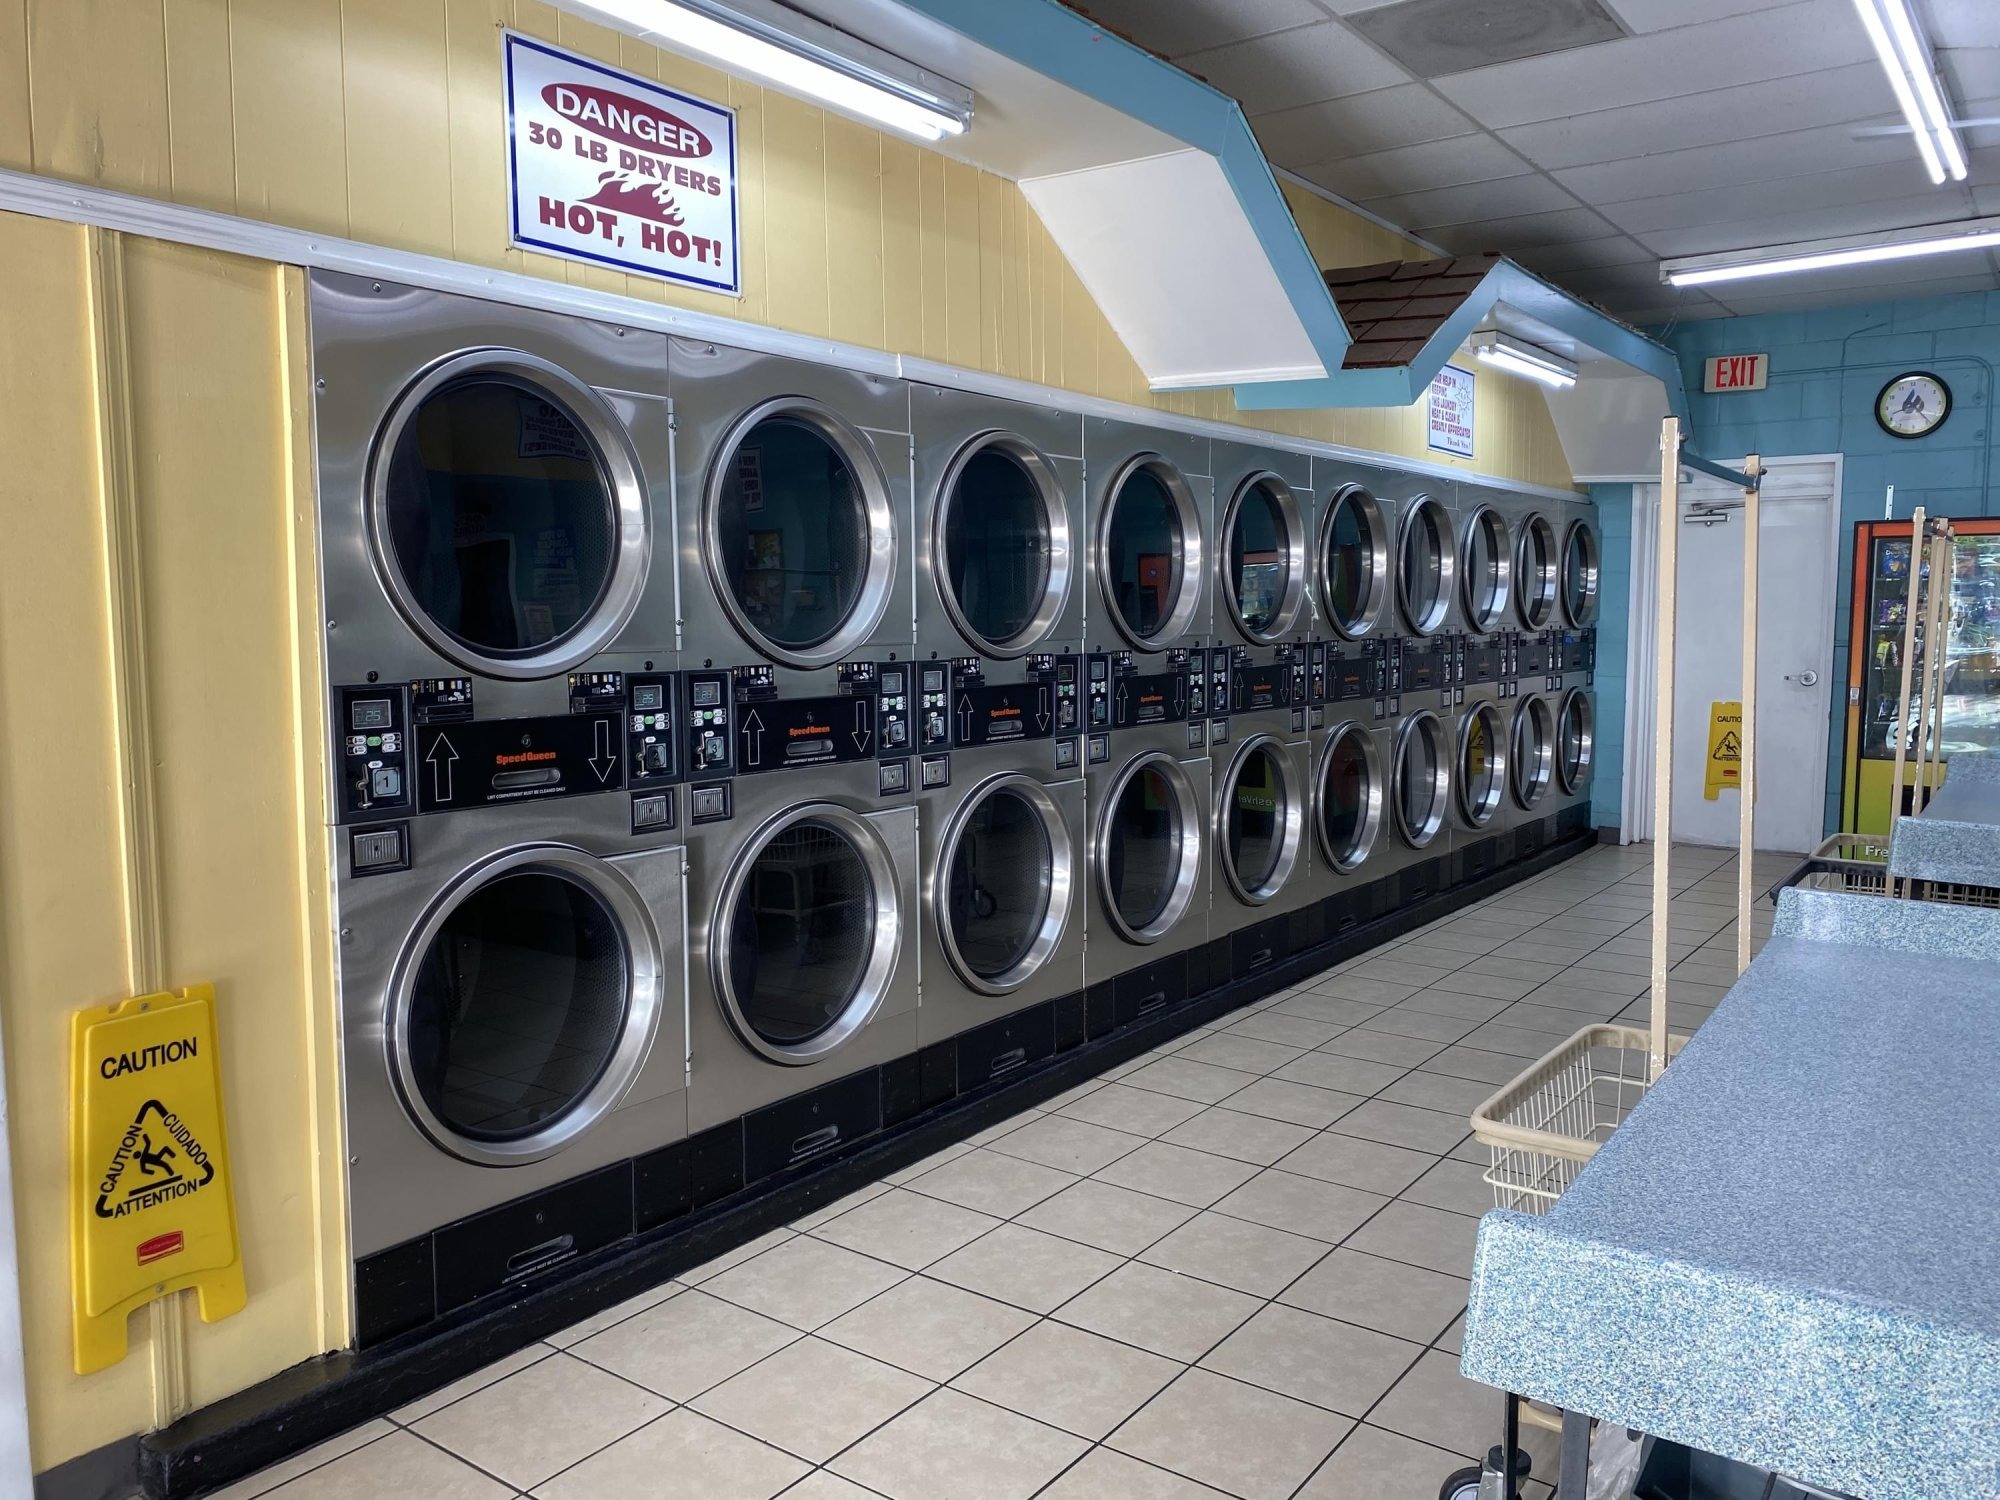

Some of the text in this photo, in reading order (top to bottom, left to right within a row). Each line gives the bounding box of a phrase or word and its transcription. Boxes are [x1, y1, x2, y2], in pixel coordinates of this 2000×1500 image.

[555, 86, 701, 156] DANGER
[529, 121, 721, 196] 30 LB DRYERS
[539, 195, 722, 267] HOT, HOT!
[1715, 355, 1759, 388] EXIT
[365, 710, 381, 721] 25
[1717, 715, 1742, 723] CAUTIO
[495, 751, 557, 765] Speed Queen
[711, 744, 718, 754] 3
[383, 775, 389, 788] 1
[1865, 845, 1889, 858] Fre
[100, 1036, 198, 1080] CAUTION
[163, 1113, 208, 1166] CUIDADO
[100, 1123, 143, 1194] CAUTION
[113, 1178, 198, 1219] ATTENTION
